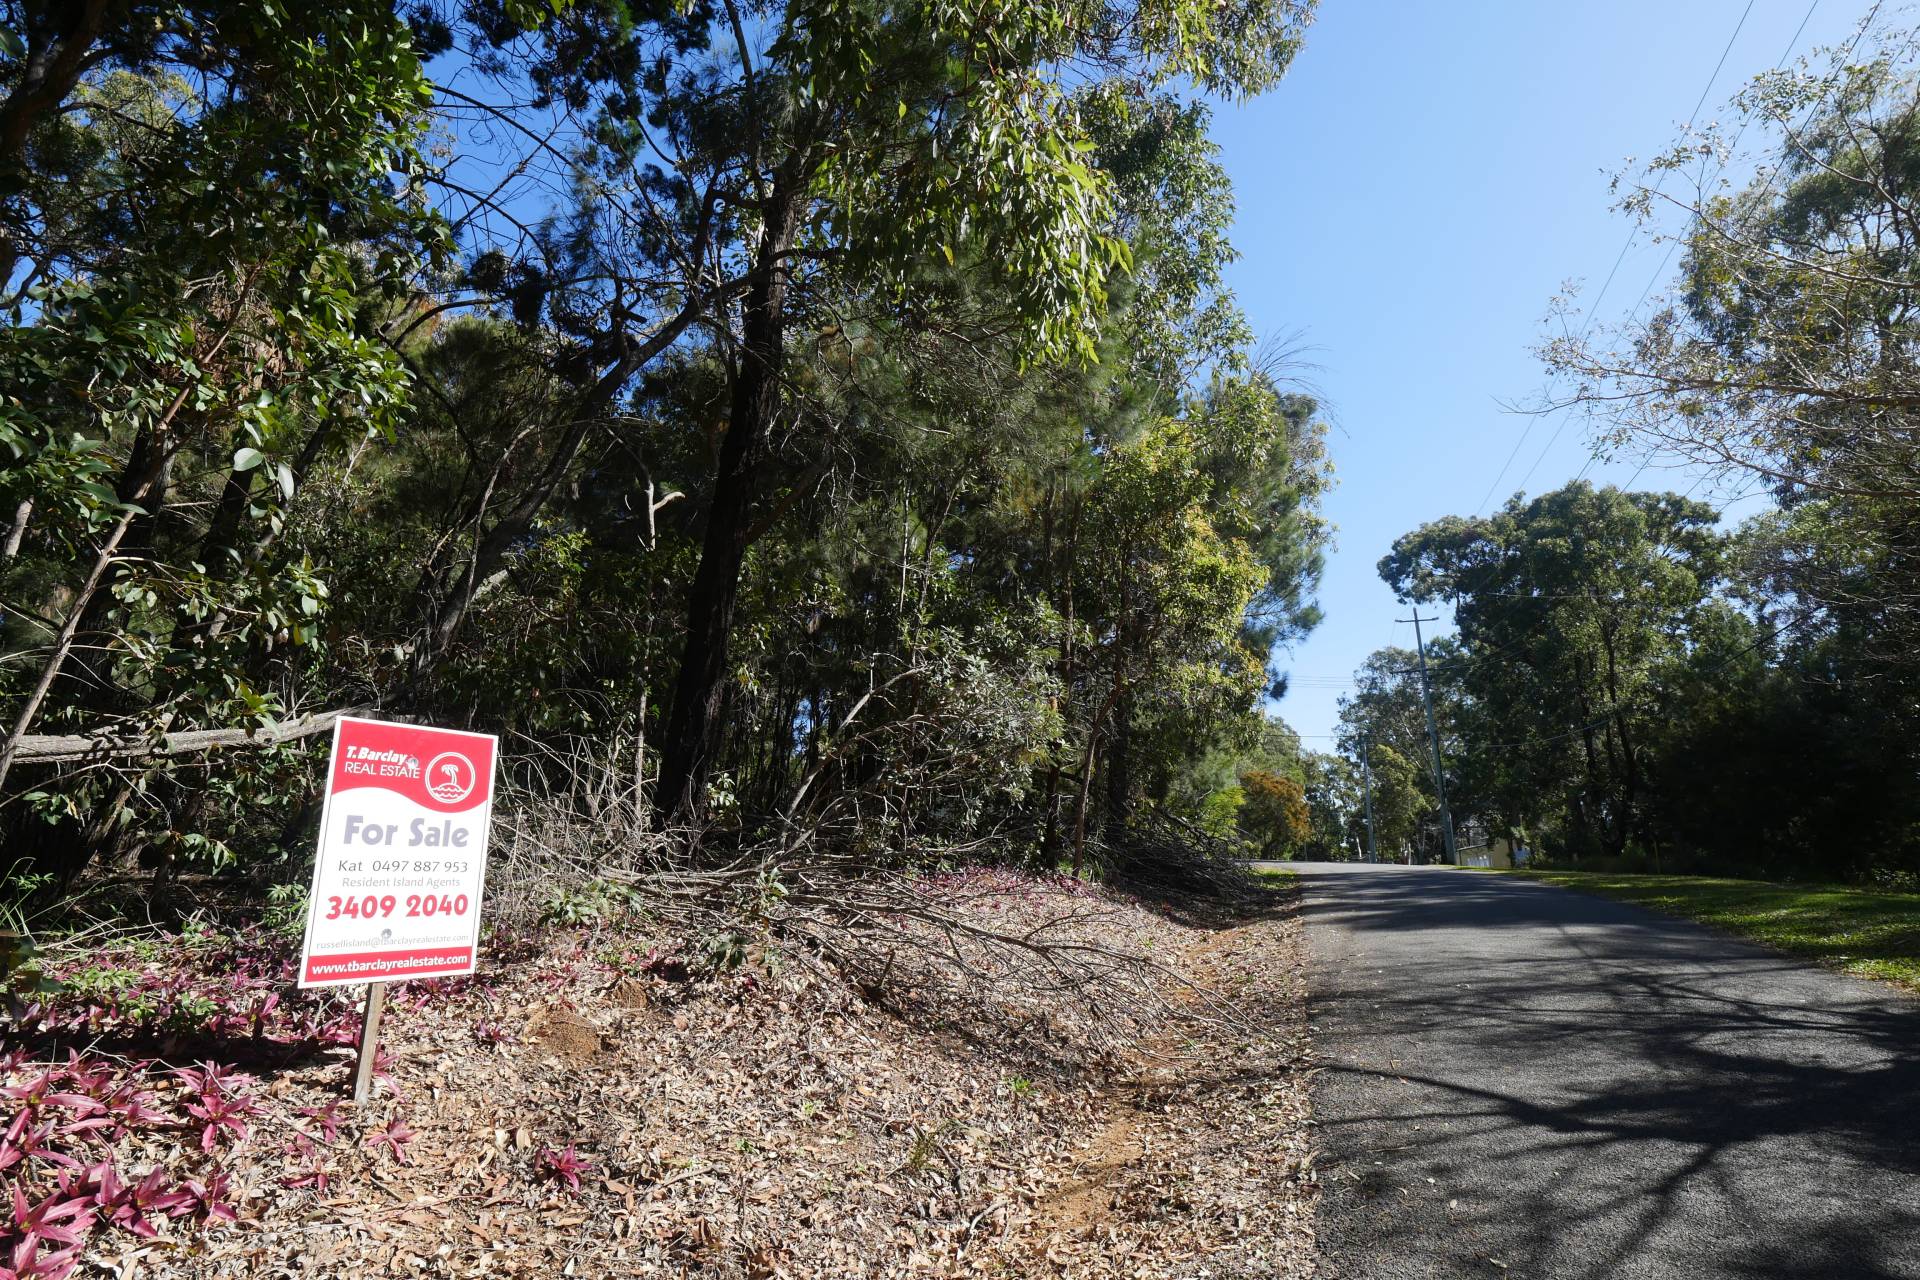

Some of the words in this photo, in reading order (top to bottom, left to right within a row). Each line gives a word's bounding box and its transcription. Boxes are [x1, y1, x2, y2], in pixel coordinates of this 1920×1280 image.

[344, 761, 377, 775] REAL
[380, 764, 421, 779] ESTATE
[343, 814, 398, 846] For
[408, 817, 469, 848] Sale
[338, 859, 363, 872] Kat
[372, 859, 409, 872] 0497
[413, 860, 440, 872] 887
[444, 861, 468, 873] 953
[342, 876, 390, 888] Resident
[393, 876, 424, 888] Island
[426, 877, 461, 890] Agents
[325, 895, 396, 920] 3409
[405, 894, 469, 917] 2040
[312, 955, 468, 975] www.tbarclayrealestate.com
